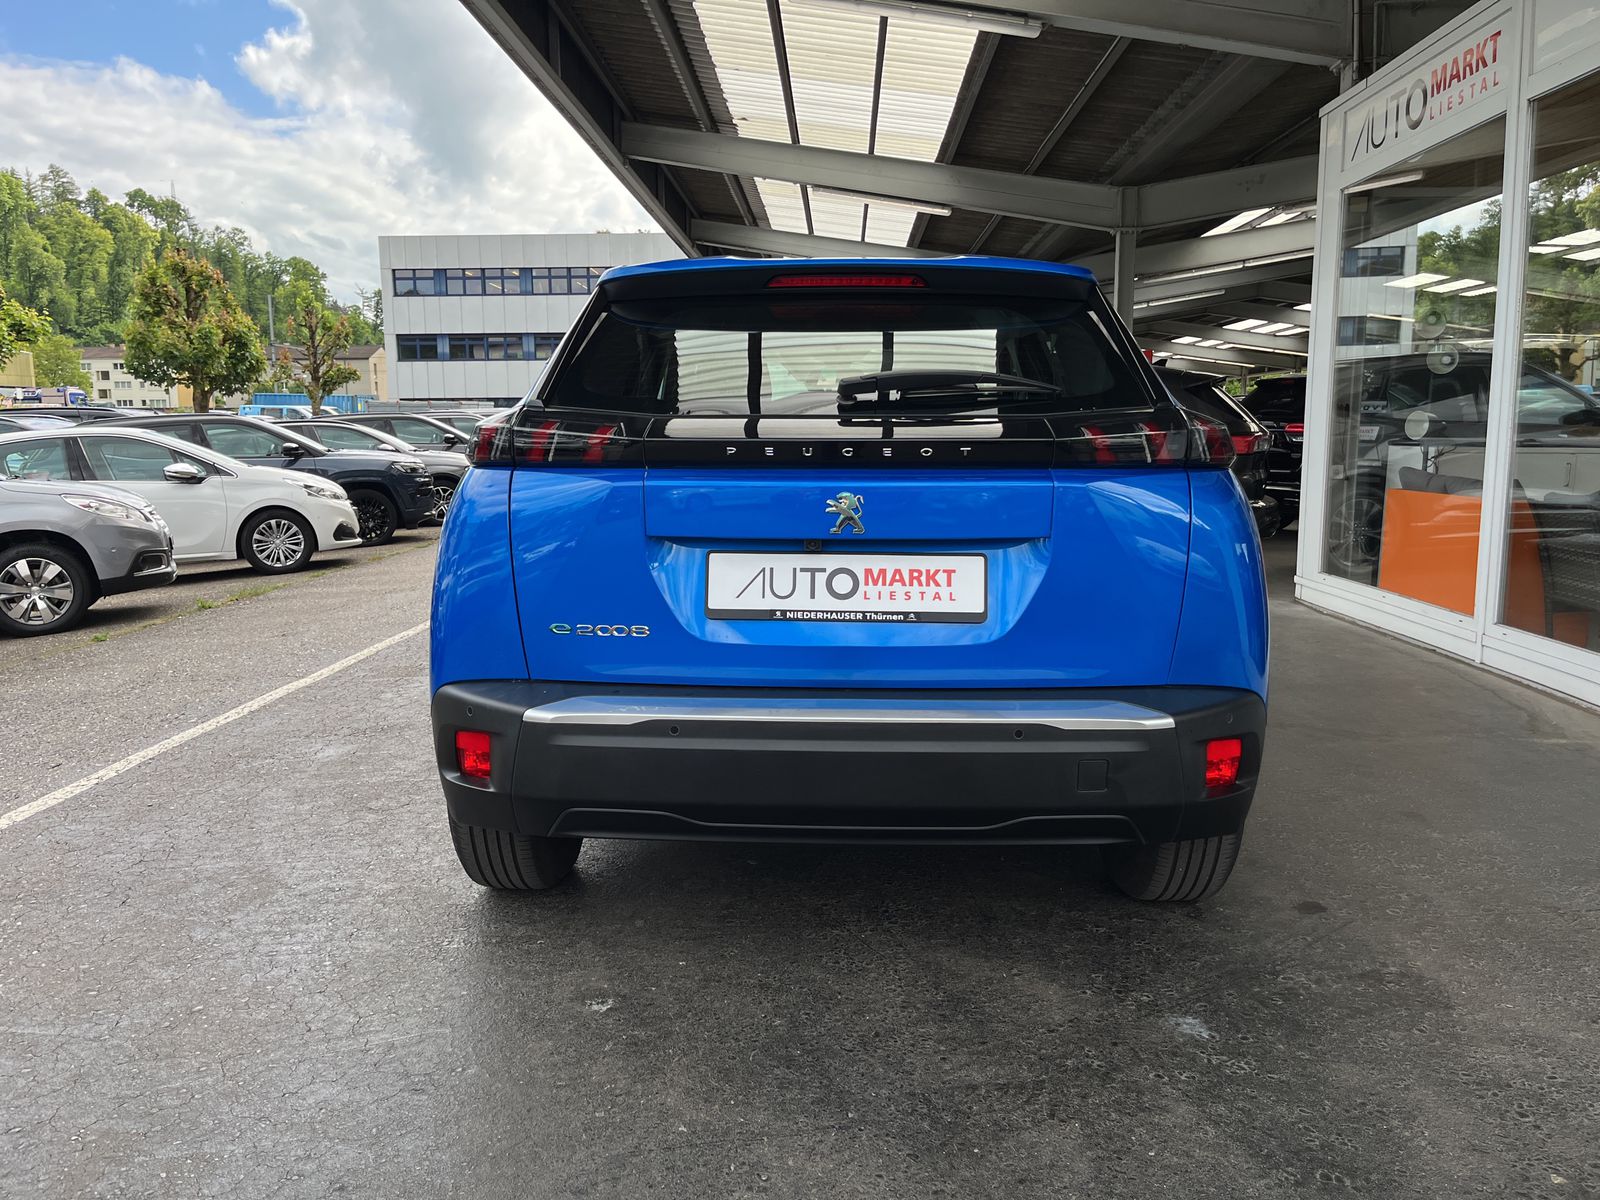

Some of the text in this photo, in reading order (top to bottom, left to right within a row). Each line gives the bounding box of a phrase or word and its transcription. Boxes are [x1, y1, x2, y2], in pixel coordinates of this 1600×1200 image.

[1351, 29, 1502, 162] AUTO MARKT
[1429, 77, 1500, 121] LIESTAL
[726, 447, 972, 457] PEUGEOT
[736, 567, 957, 601] AUTO MARKT
[864, 590, 957, 602] LIESTAL
[786, 611, 904, 621] NIEDERHAUSER Thürnen
